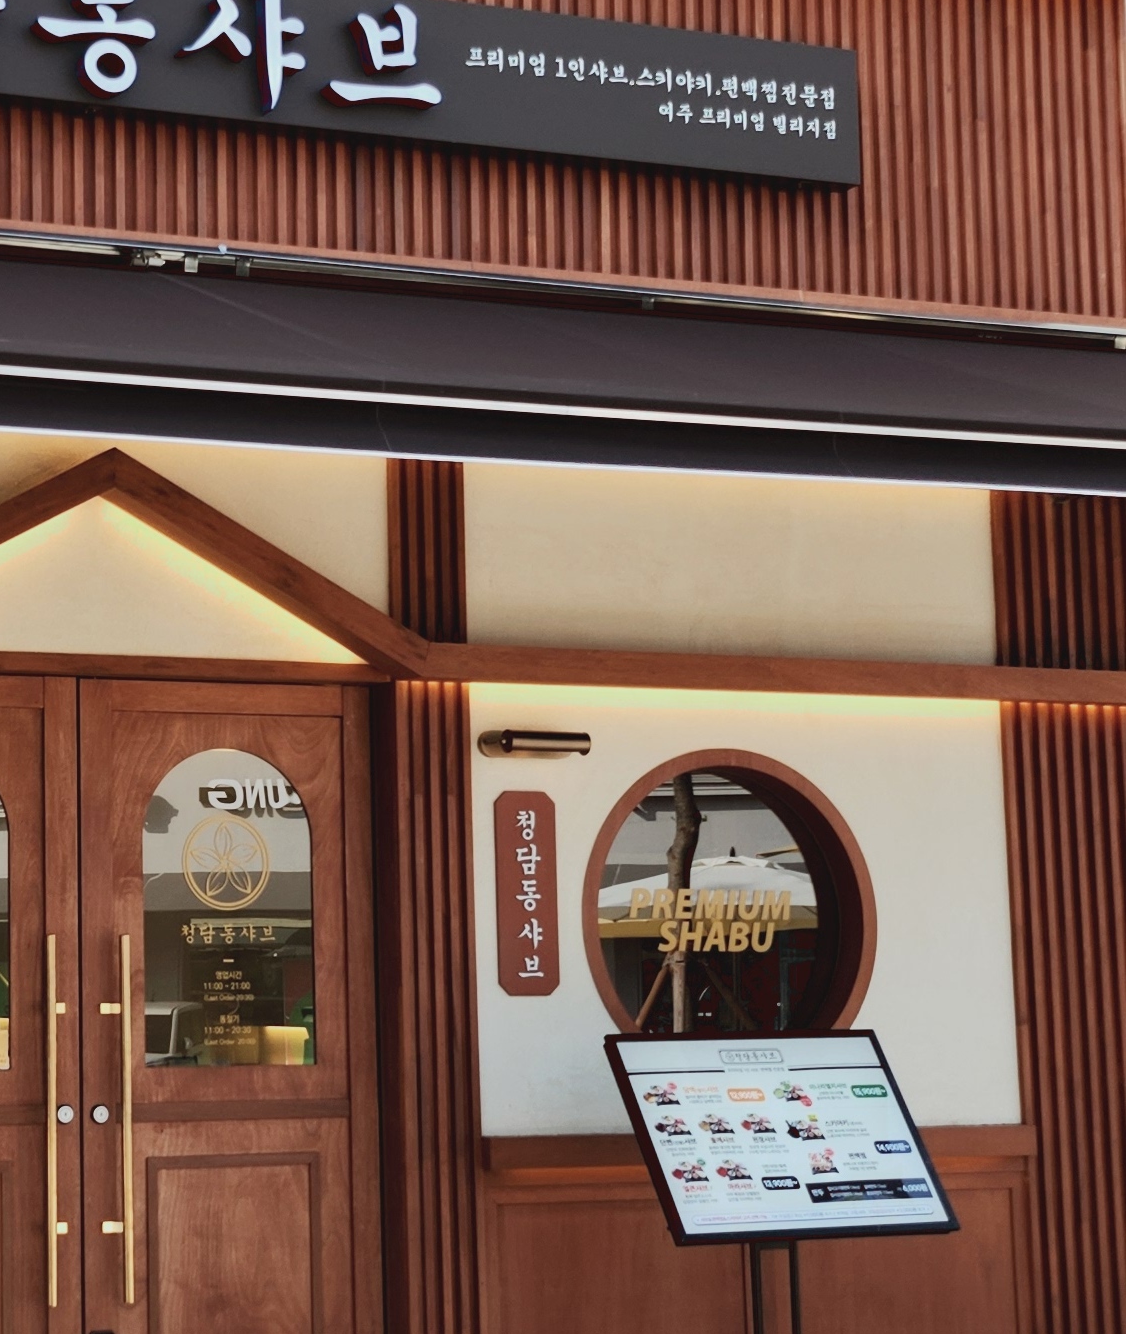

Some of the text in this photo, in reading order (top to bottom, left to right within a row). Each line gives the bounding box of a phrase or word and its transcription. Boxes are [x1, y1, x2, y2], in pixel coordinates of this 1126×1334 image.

[465, 46, 546, 77] 프리미엄
[658, 100, 837, 140] 여주 프리미엄 빌리지점
[513, 809, 545, 980] 청담동샤브
[629, 888, 792, 921] PREMIUM
[181, 923, 276, 944] 청담동샤브
[657, 920, 775, 953] SHABU
[203, 981, 223, 990] 11:00
[230, 981, 251, 990] 21:00
[203, 1026, 224, 1034] 11:00
